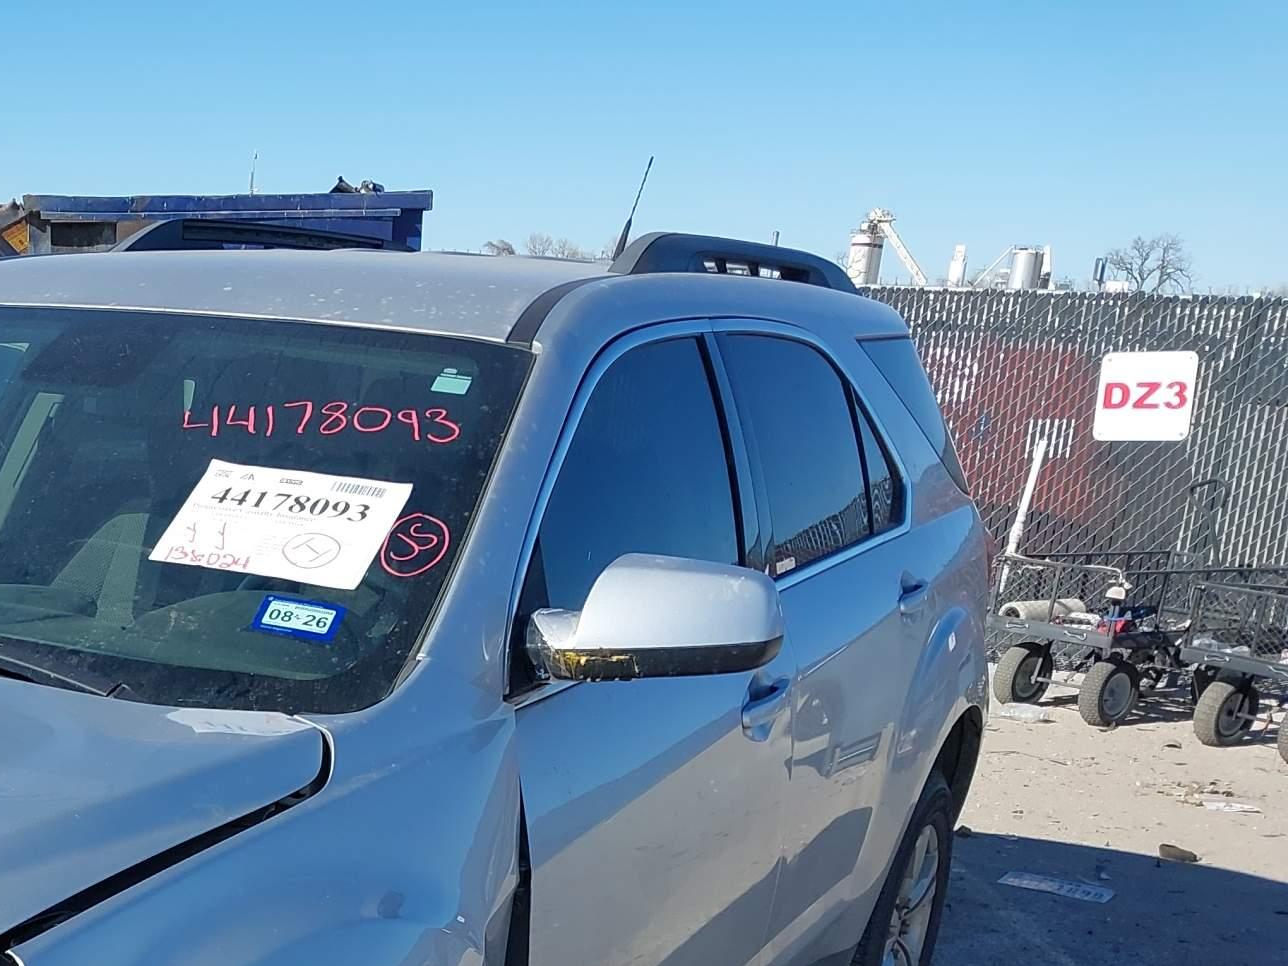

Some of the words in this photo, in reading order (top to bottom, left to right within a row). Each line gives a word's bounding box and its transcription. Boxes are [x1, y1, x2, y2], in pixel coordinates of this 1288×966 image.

[1102, 381, 1188, 410] DZ3
[182, 400, 461, 443] 44178093
[210, 486, 371, 523] 44178093
